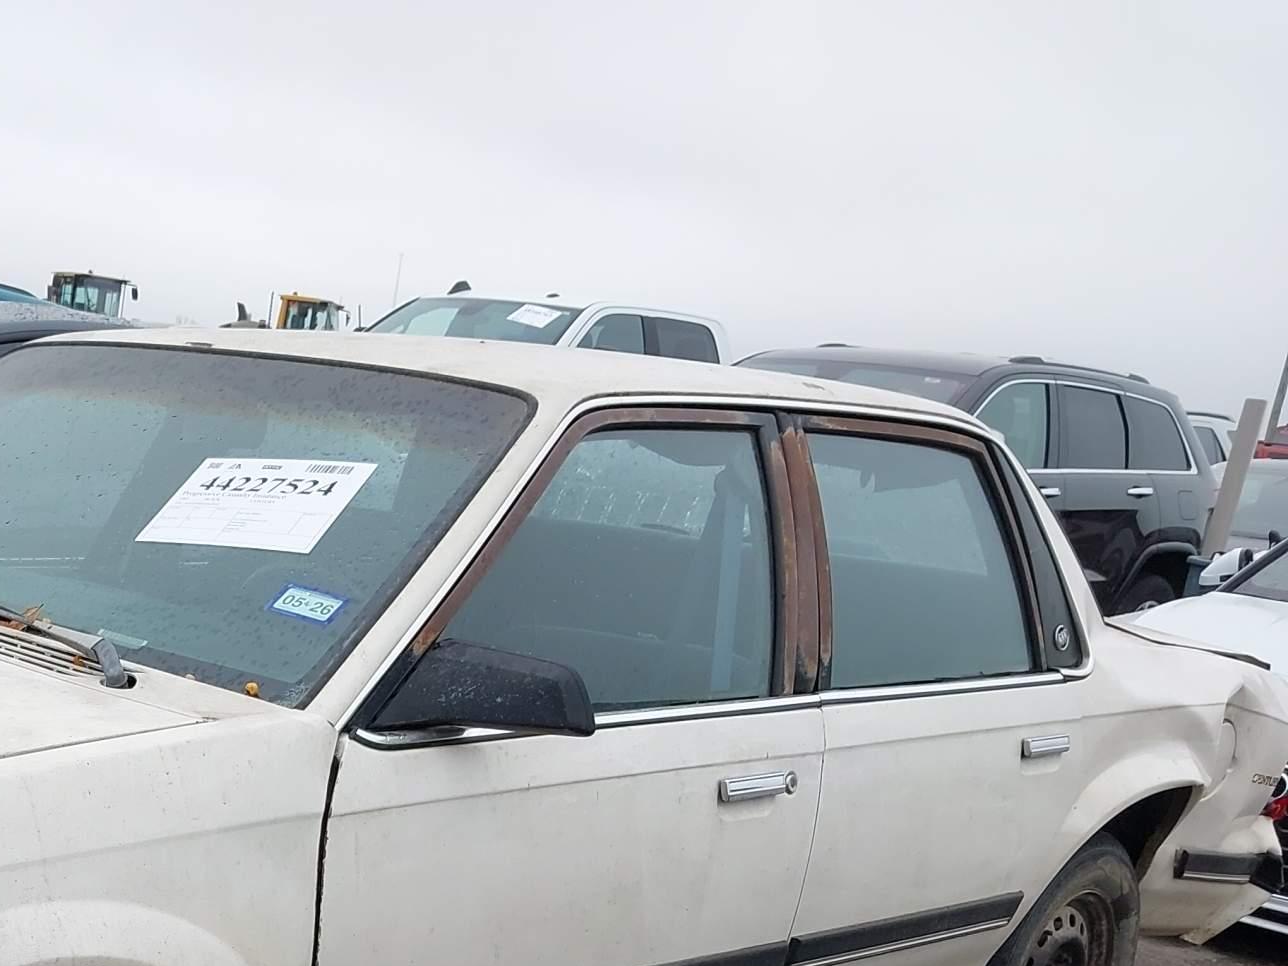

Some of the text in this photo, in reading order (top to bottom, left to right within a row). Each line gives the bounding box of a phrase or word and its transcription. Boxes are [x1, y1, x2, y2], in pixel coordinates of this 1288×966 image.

[199, 476, 339, 497] 44227524
[281, 594, 335, 616] 05 26
